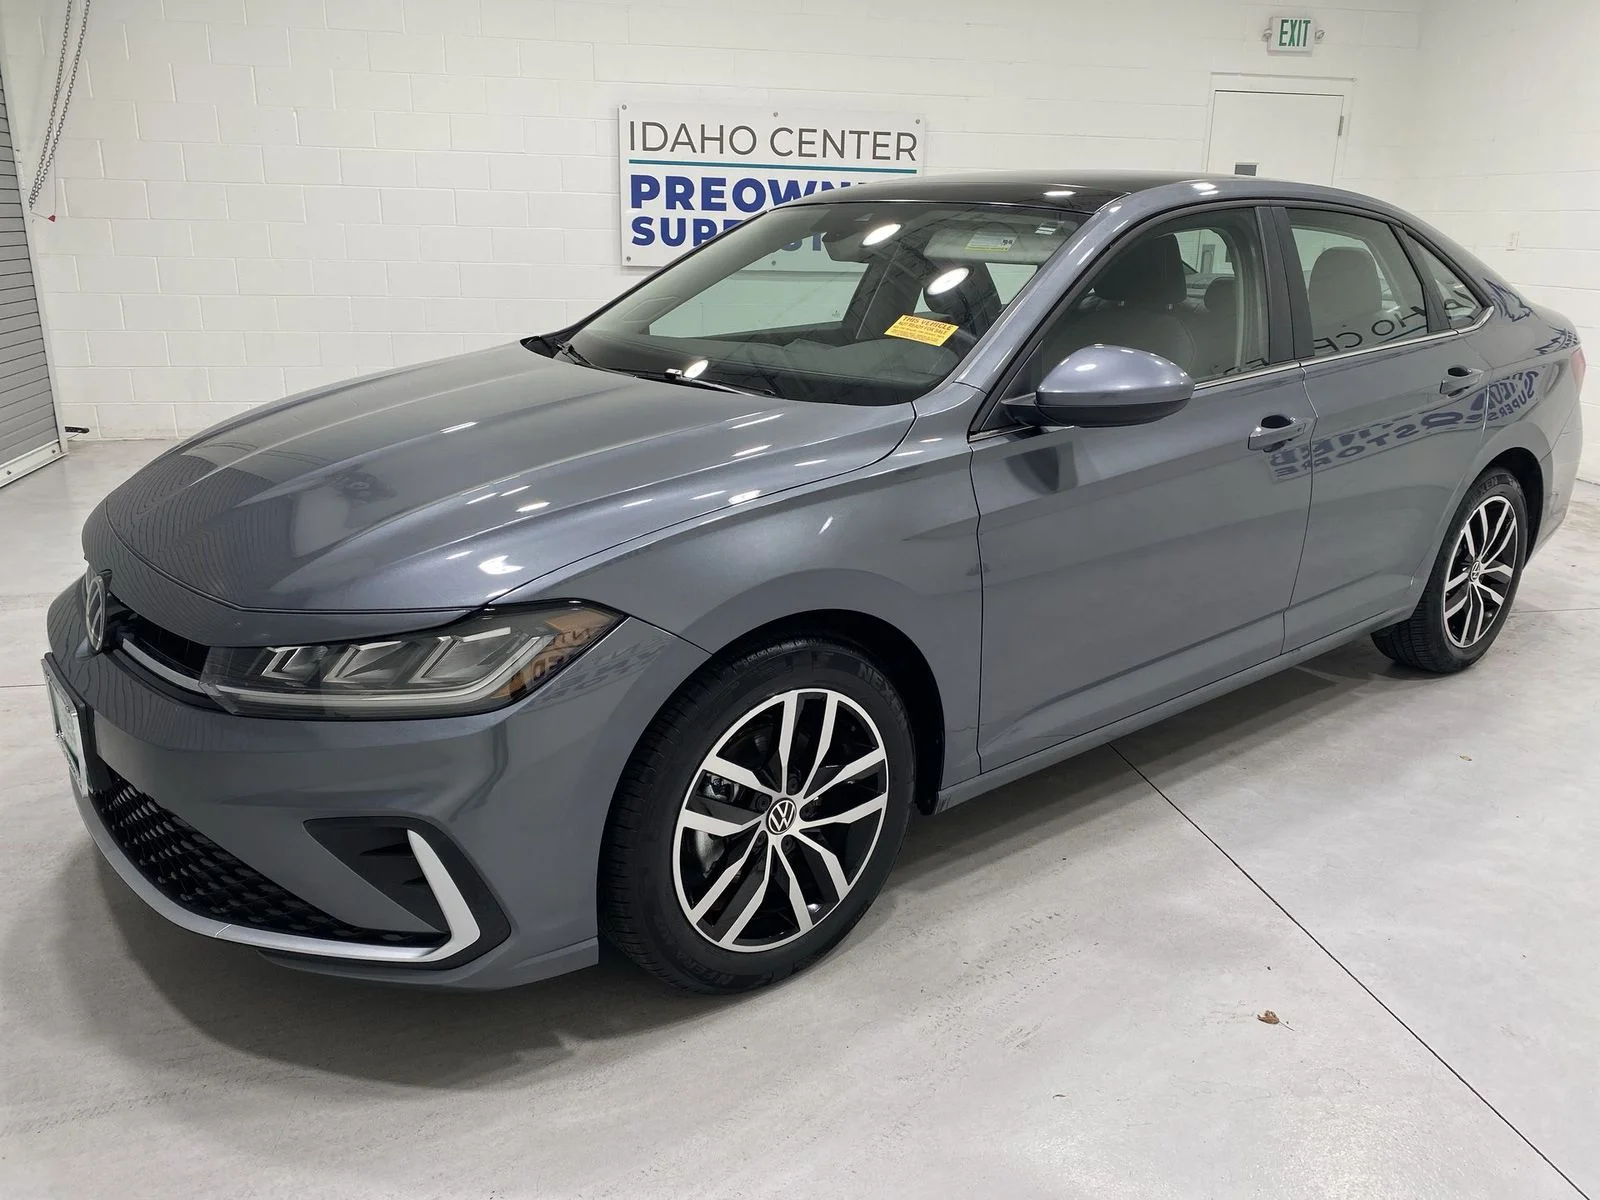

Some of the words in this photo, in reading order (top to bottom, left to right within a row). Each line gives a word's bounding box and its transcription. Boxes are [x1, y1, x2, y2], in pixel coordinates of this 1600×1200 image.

[1278, 19, 1311, 47] EXIT
[629, 120, 757, 155] IDAHO
[769, 127, 917, 161] CENTER
[630, 174, 866, 213] PREOW
[921, 320, 954, 330] VEHICLE
